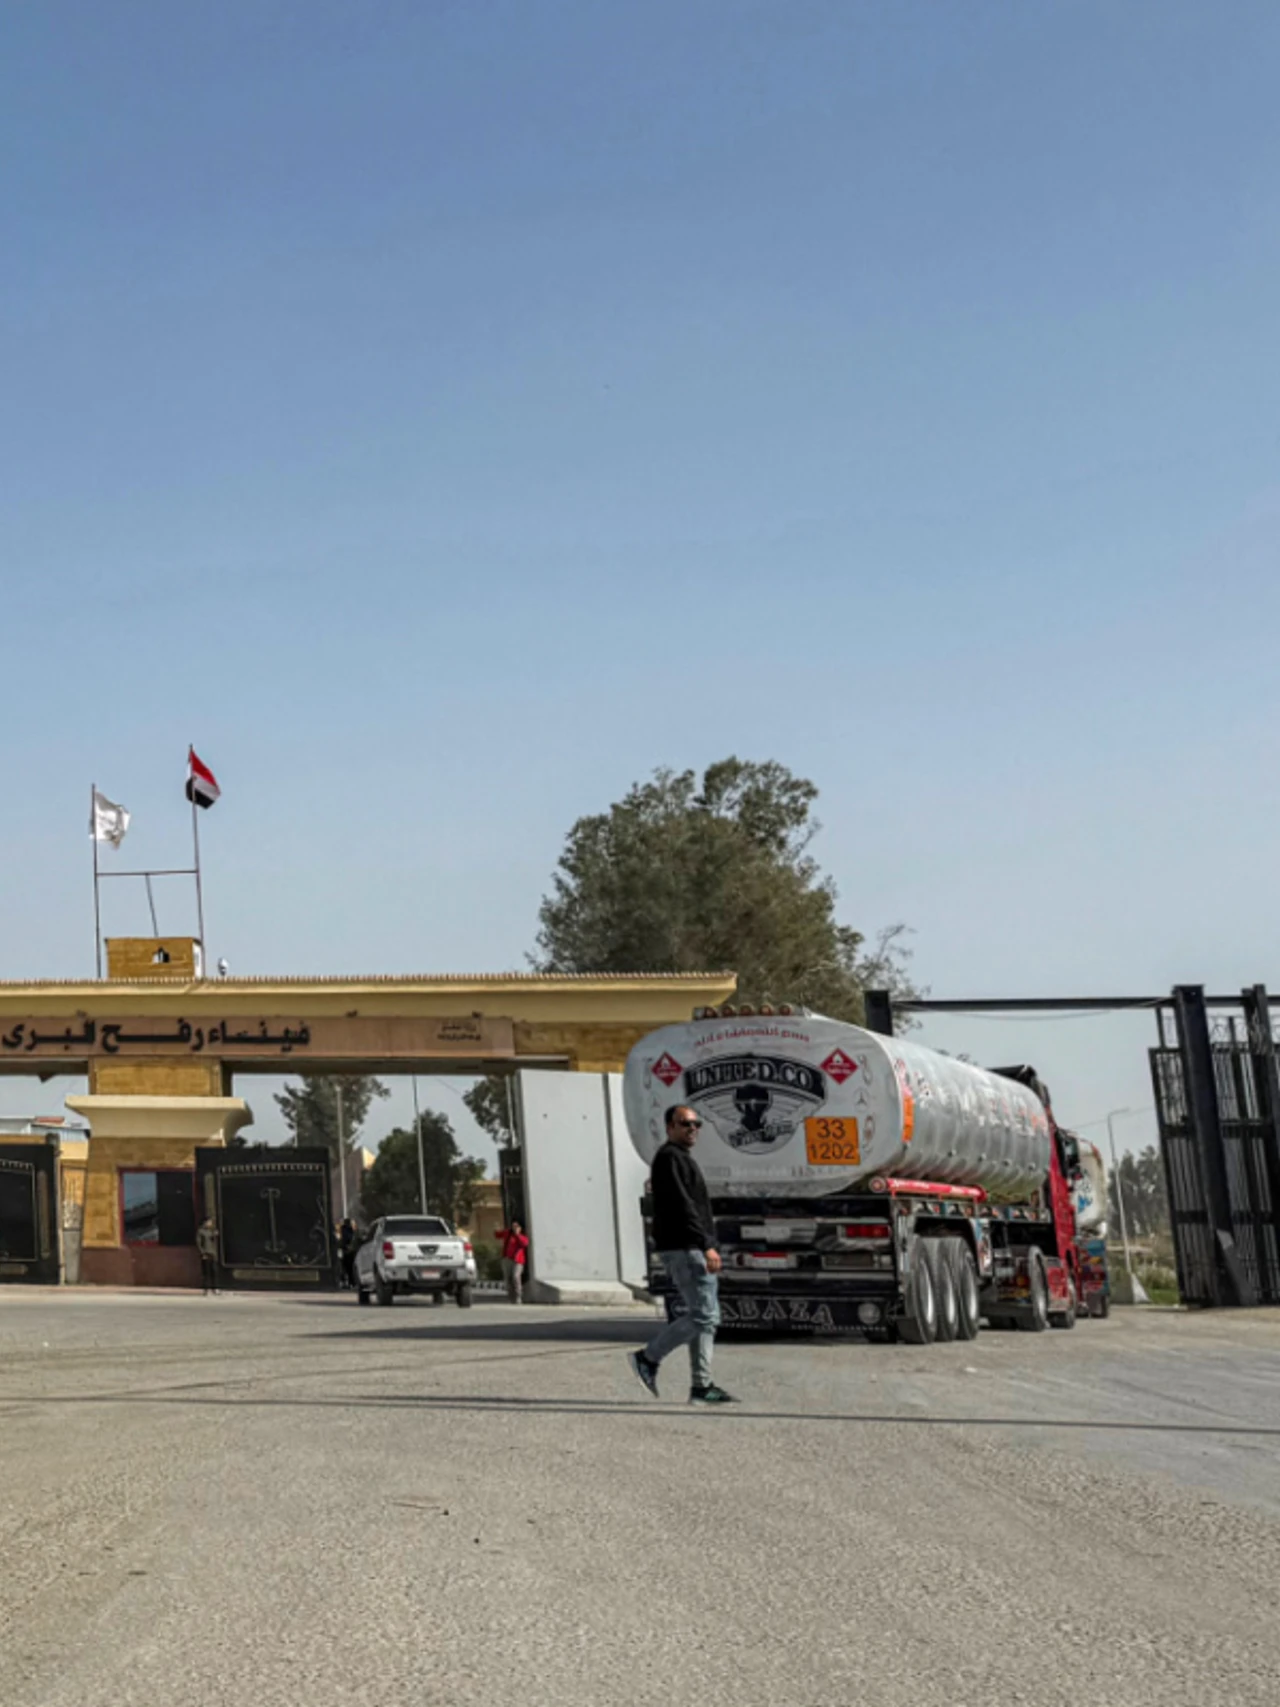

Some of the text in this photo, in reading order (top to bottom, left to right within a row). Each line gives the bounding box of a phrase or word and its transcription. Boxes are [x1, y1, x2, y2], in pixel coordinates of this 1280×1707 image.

[100, 1017, 205, 1053] رفح
[207, 1018, 311, 1053] ميناء
[816, 1119, 846, 1140] 33
[810, 1143, 856, 1161] 1202
